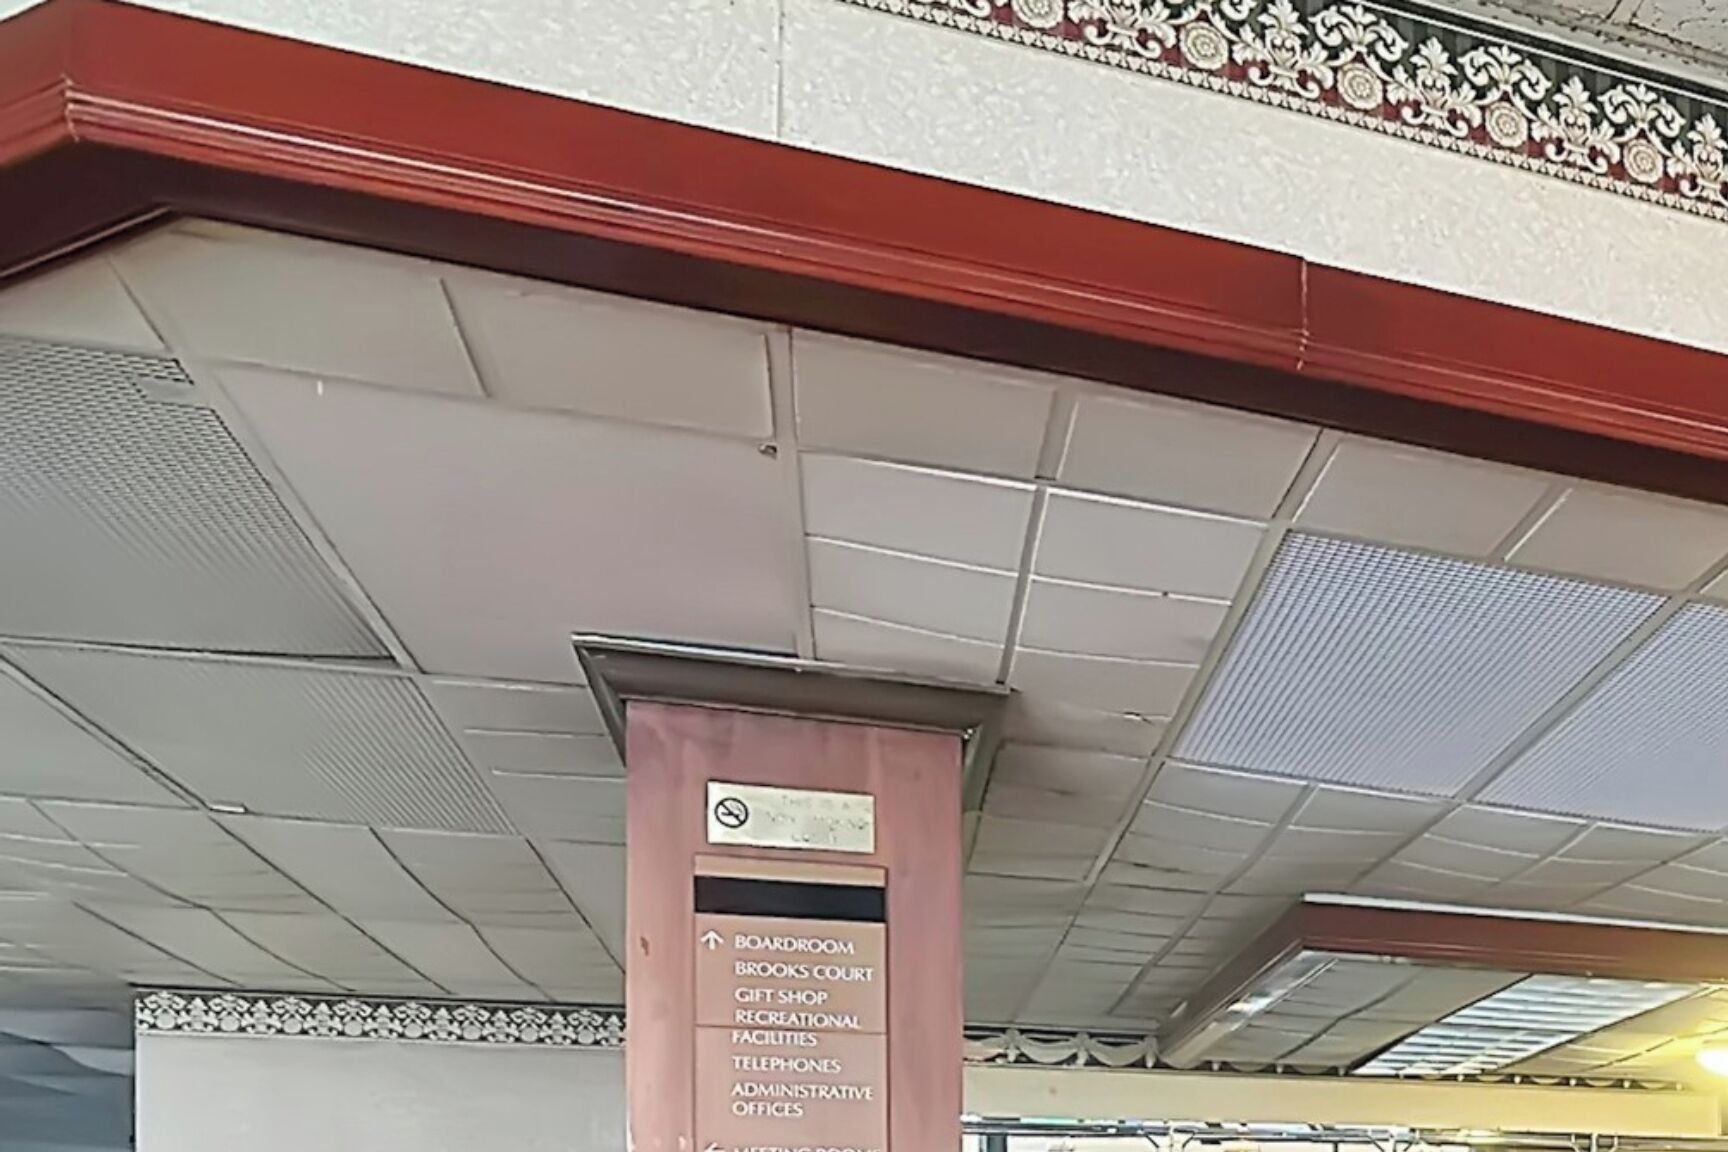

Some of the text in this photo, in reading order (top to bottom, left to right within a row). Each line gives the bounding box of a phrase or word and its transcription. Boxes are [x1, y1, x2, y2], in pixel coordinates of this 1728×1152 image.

[734, 934, 855, 955] BOARDROOM
[734, 960, 874, 981] BROOKS COURT
[734, 986, 828, 1006] GIFT SHOP
[735, 1009, 862, 1029] RECREATIONAL
[731, 1030, 818, 1047] FACILITIES
[731, 1055, 842, 1074] TELEPHONES
[731, 1081, 874, 1101] ADMINISTRATIVE
[732, 1100, 804, 1117] OFFICES
